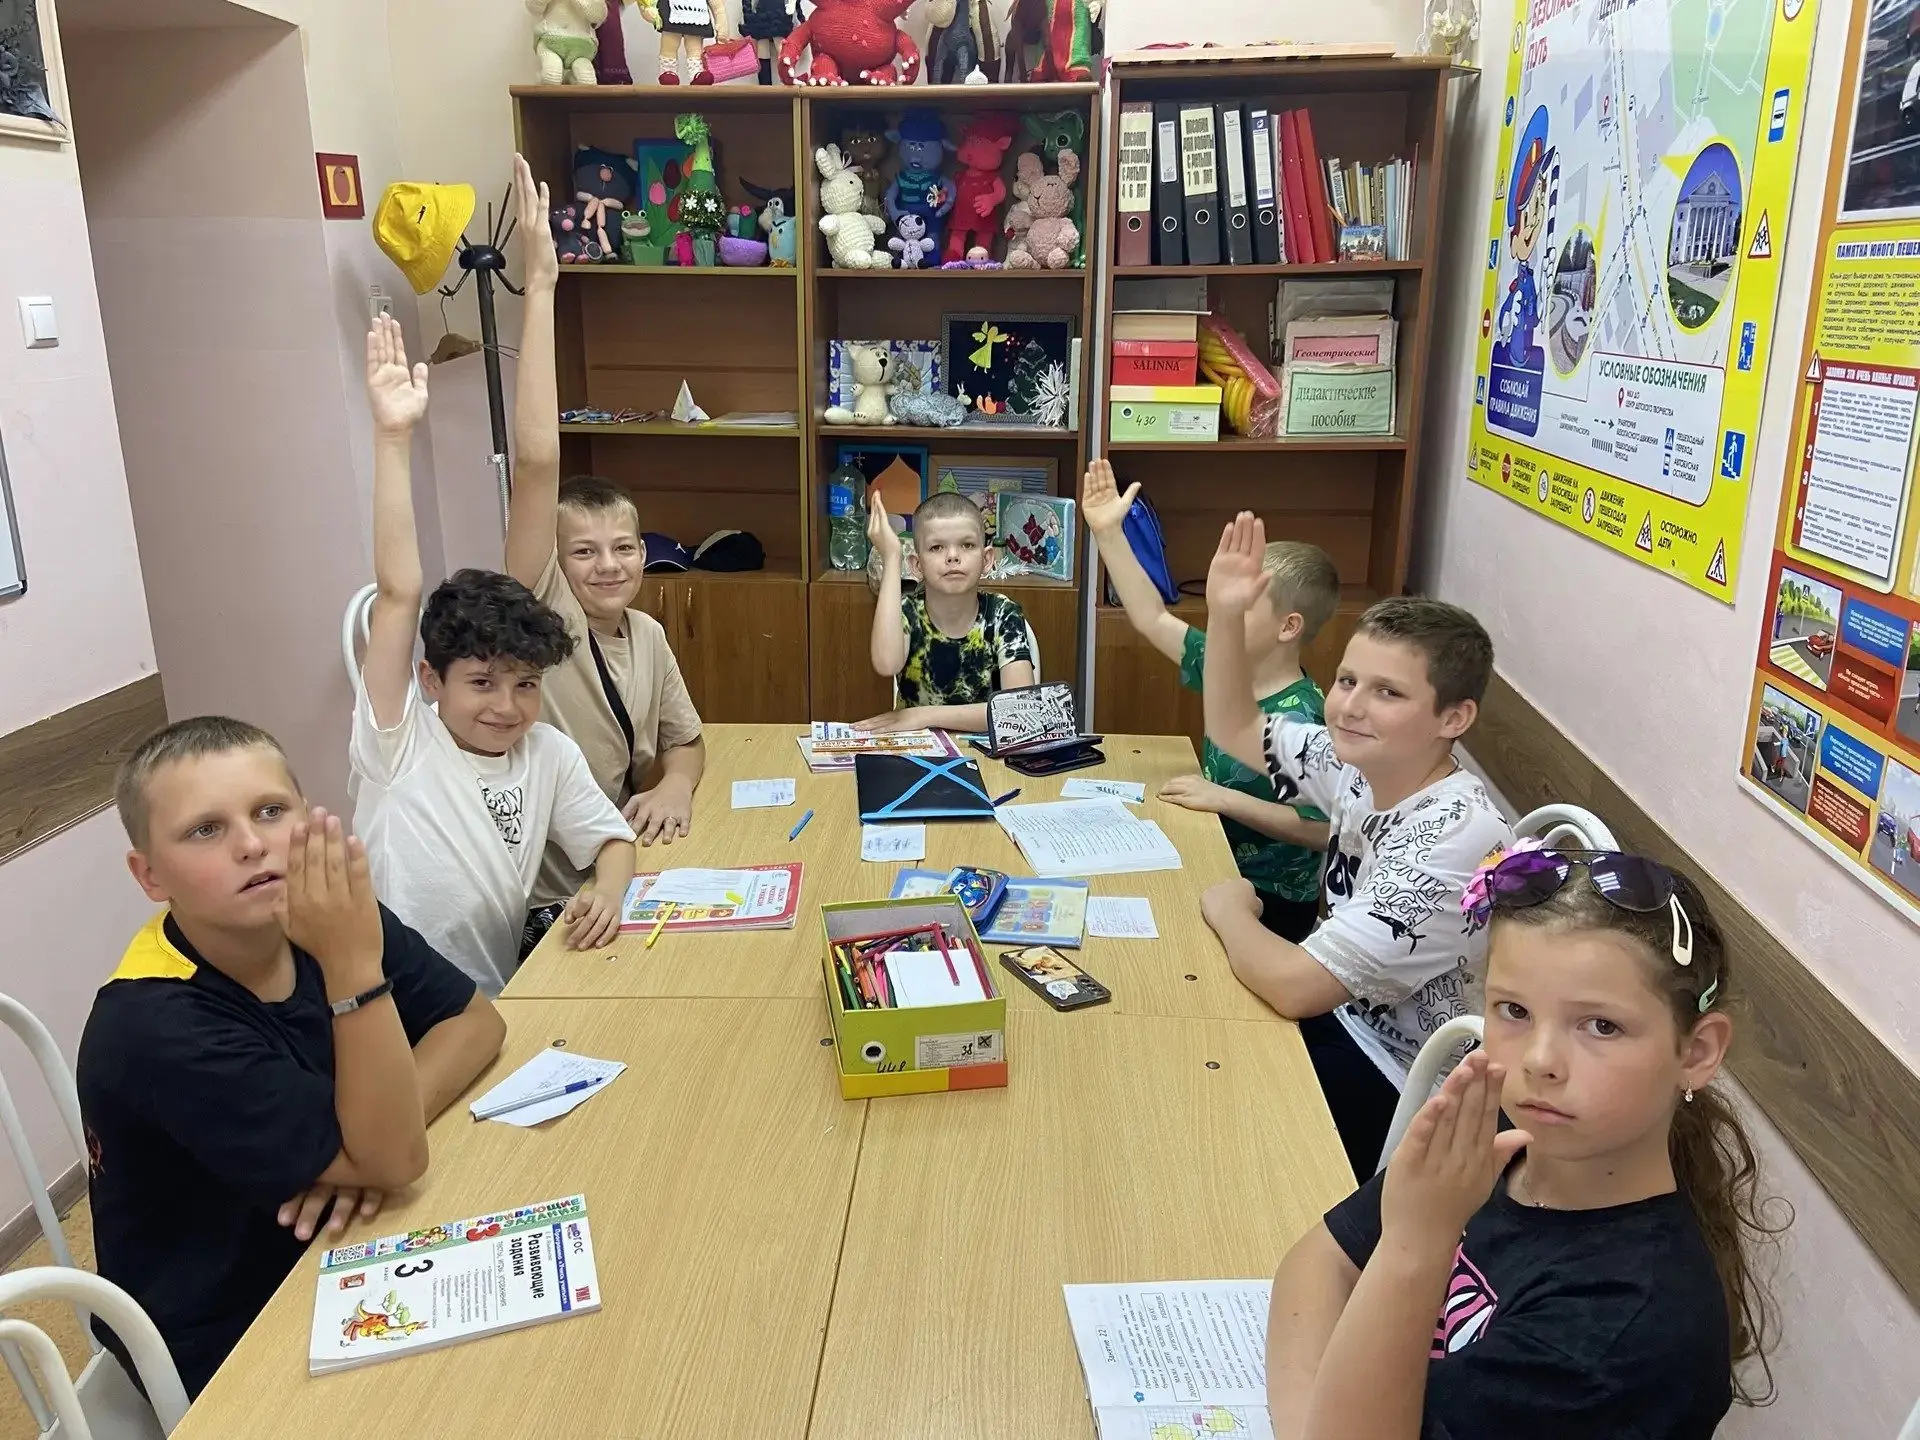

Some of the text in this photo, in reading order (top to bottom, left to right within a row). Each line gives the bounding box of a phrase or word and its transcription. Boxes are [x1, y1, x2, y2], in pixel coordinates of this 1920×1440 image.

[1526, 36, 1549, 71] ПУТЬ
[1837, 244, 1868, 258] ПАМЯТКА
[1869, 243, 1895, 257] ЮНОГО
[1295, 349, 1376, 359] Геометрические
[1133, 360, 1180, 371] SALINNA
[1599, 360, 1707, 393] УСЛОВНЫЕ ОБОЗНАЧЕНИЯ
[1296, 384, 1377, 402] дидактические
[1500, 378, 1530, 398] СОБЛЮДАЙ
[1489, 397, 1537, 424] ПРАВИЛА ДВИЖЕНИЯ
[1814, 402, 1819, 416] 1
[1136, 415, 1156, 426] 430
[1311, 410, 1357, 427] пособия
[1806, 444, 1812, 458] 2
[1673, 457, 1699, 473] АВТОБУСНАЯ
[1672, 467, 1696, 483] ОСТАНОВКА
[1802, 470, 1808, 485] 3
[1600, 490, 1624, 508] ДВИЖЕНИЕ
[1598, 503, 1627, 524] ПЕШЕХОДОВ
[1797, 506, 1803, 521] 4
[1596, 517, 1624, 538] ЗАПРЕЩЕНО
[1660, 520, 1698, 546] ОСТОРОЖНО,
[1657, 537, 1673, 551] ДЕТИ
[998, 720, 1027, 733] News
[466, 1223, 501, 1242] 3
[509, 1237, 525, 1277] задания
[394, 1259, 434, 1278] 3
[528, 1232, 545, 1299] Развивающие
[575, 1286, 591, 1302] УМК
[1098, 1328, 1107, 1339] 22
